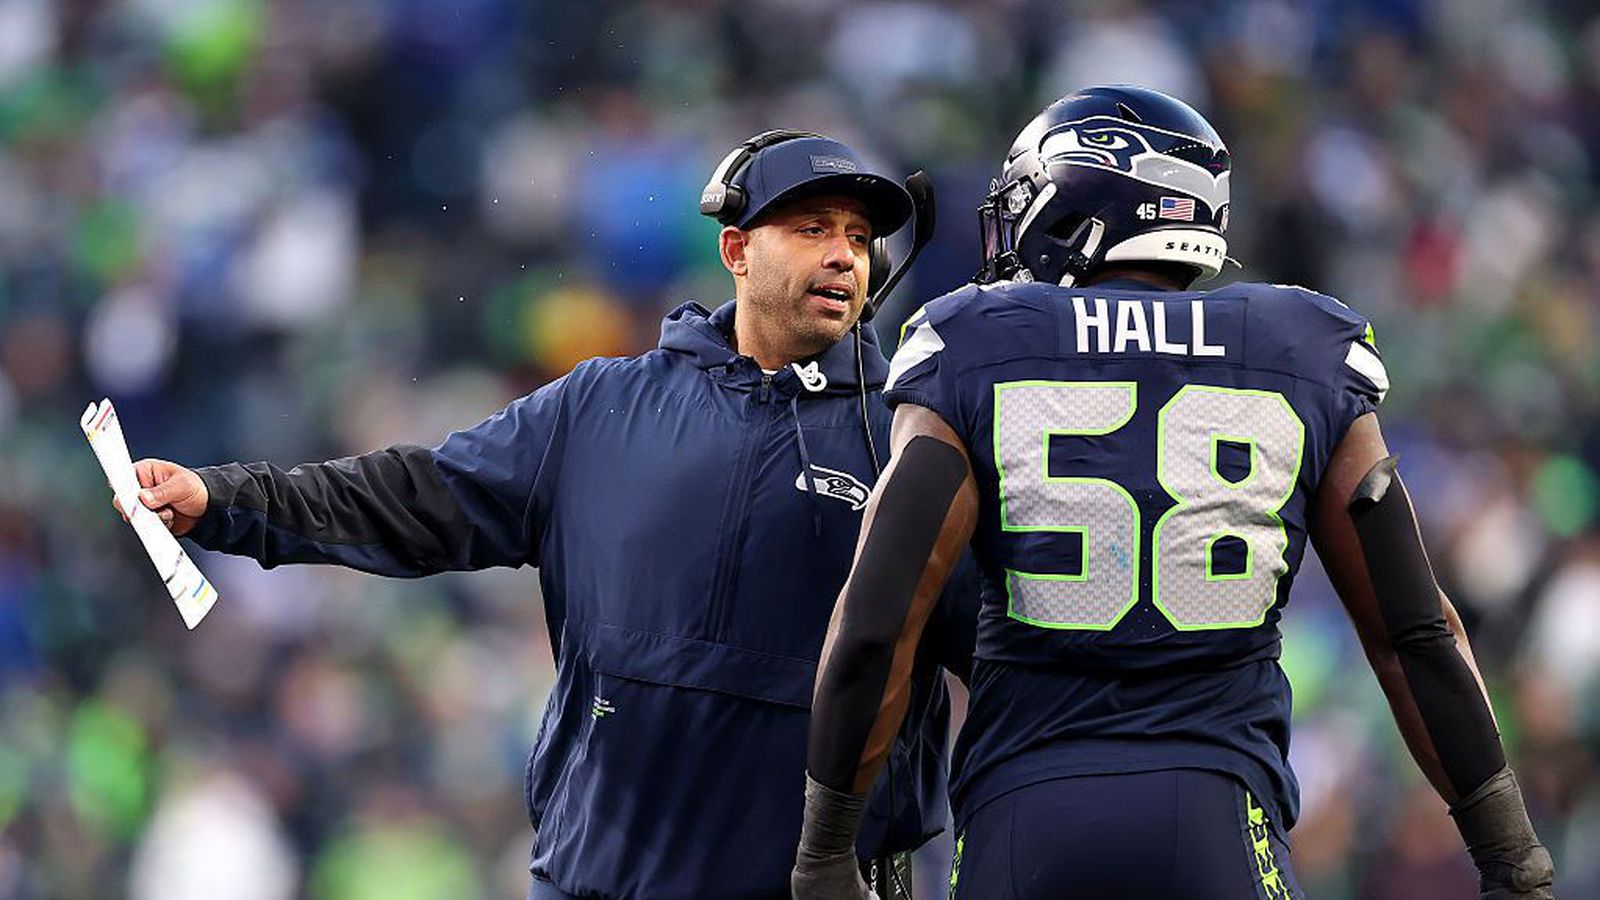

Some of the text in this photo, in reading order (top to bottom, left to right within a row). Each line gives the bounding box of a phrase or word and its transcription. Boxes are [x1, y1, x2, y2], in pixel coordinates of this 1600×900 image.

[1136, 203, 1157, 220] 45
[1072, 297, 1226, 357] HALL
[993, 380, 1306, 631] 58
